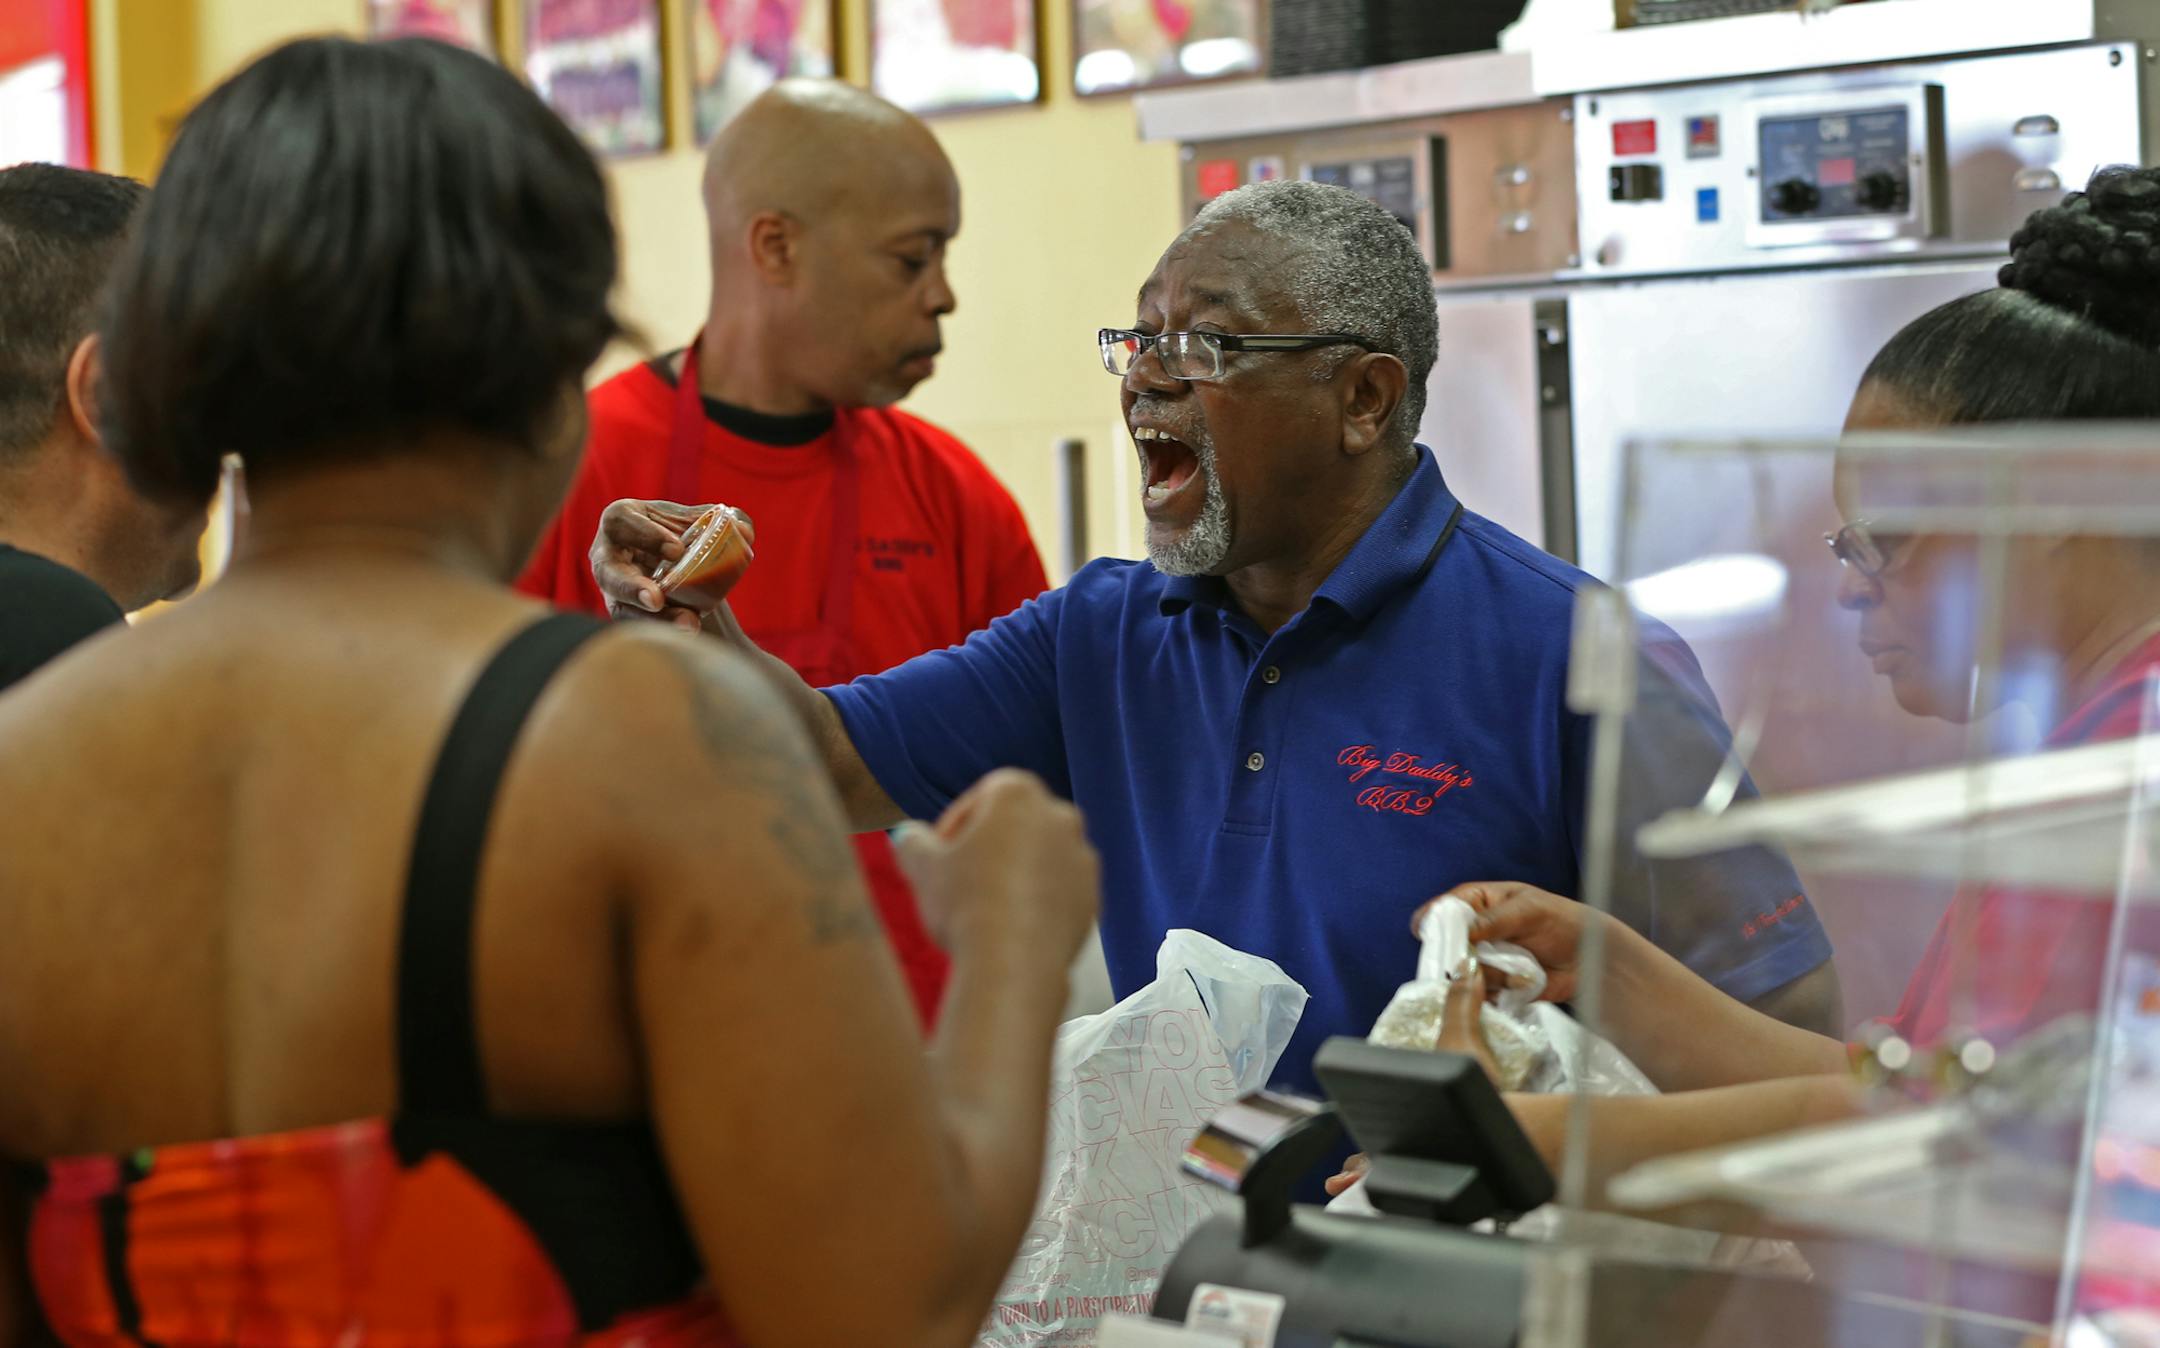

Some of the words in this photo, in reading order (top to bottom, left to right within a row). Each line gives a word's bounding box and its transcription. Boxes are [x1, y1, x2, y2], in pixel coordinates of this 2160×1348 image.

[1336, 744, 1381, 782] Big
[1382, 752, 1474, 798] Daddy's
[1031, 1300, 1047, 1322] TO
[1054, 1297, 1063, 1320] A
